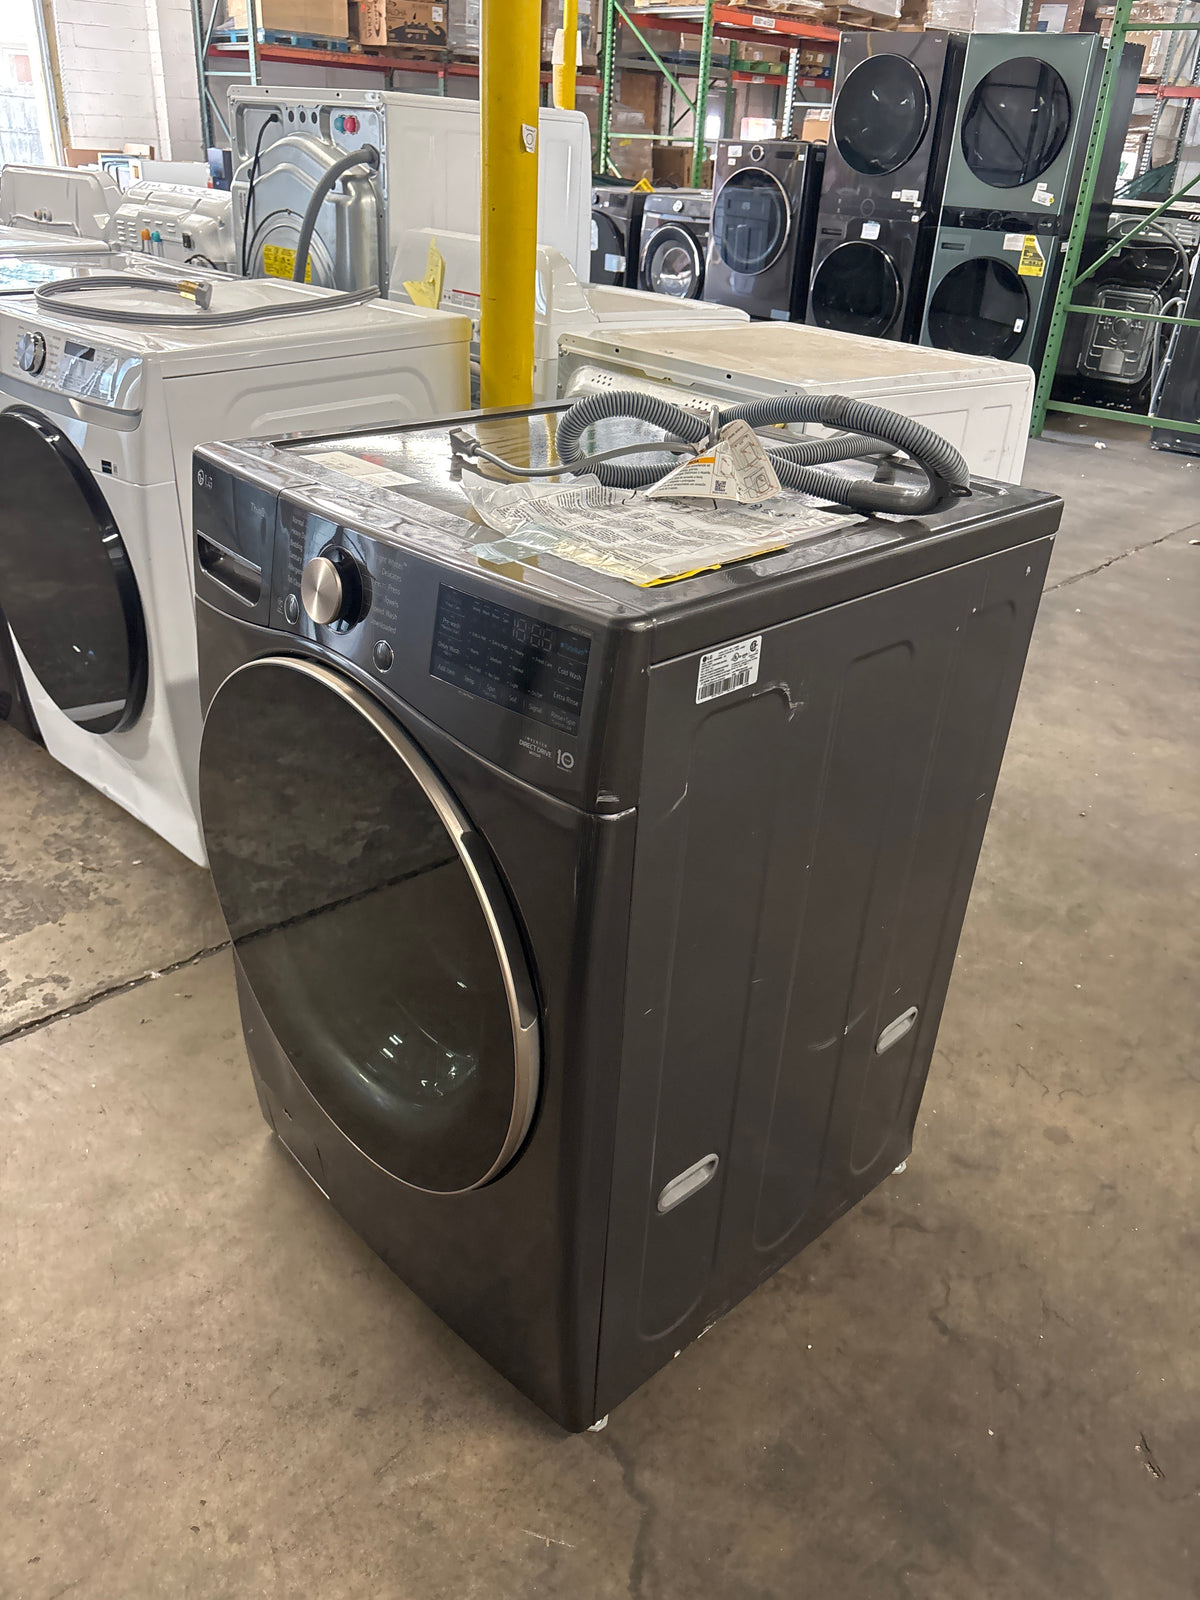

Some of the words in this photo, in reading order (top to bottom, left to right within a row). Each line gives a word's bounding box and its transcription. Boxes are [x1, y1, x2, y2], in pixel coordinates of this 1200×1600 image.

[552, 690, 566, 702] Extra
[518, 738, 538, 752] DIRECT
[556, 749, 576, 769] 10
